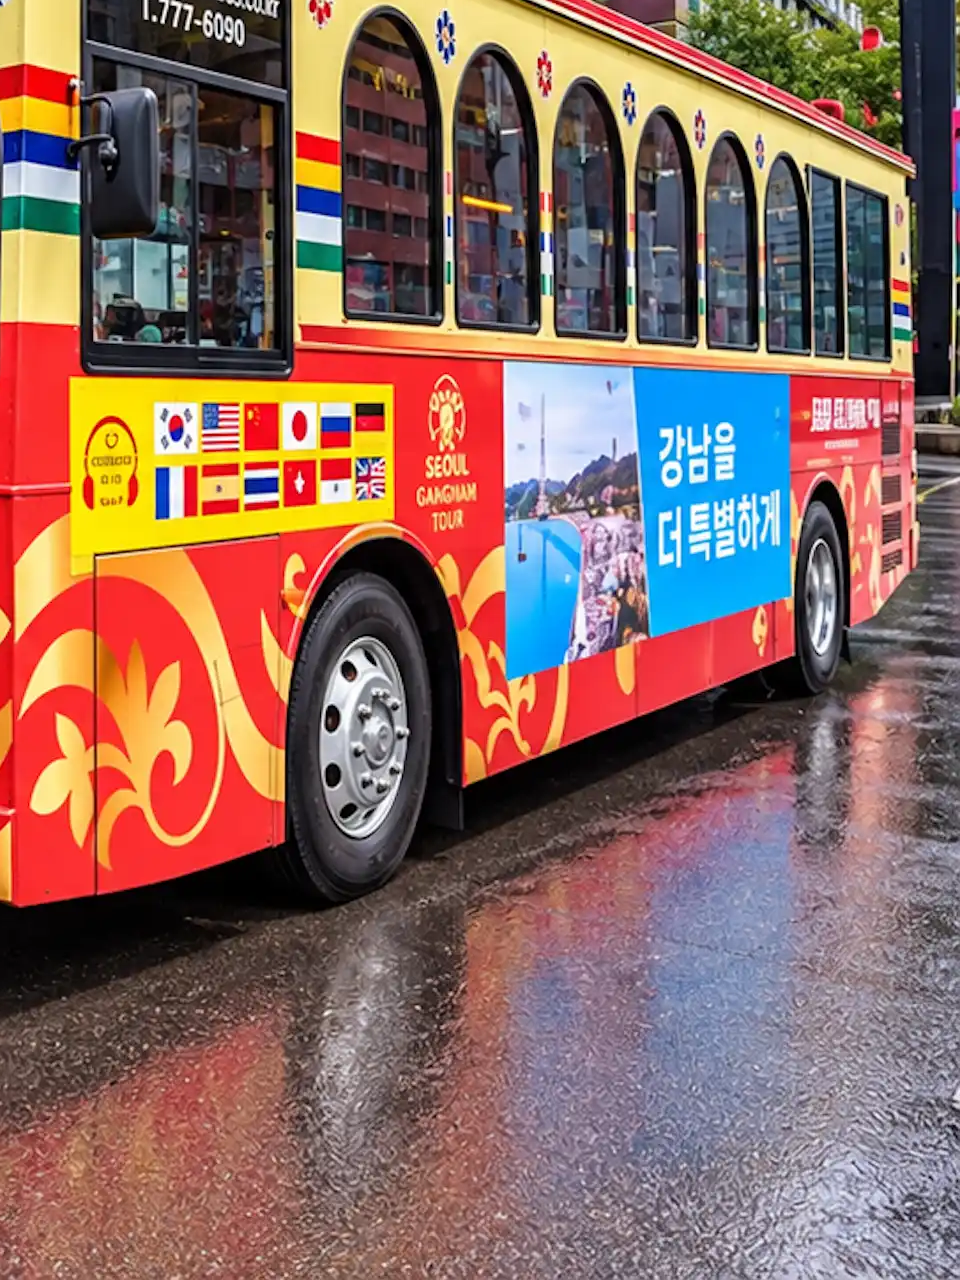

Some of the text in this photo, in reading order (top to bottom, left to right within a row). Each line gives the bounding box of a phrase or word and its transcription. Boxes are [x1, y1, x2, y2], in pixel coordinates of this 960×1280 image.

[425, 453, 470, 479] SEOUL
[658, 421, 737, 488] 강남을
[431, 509, 464, 532] TOUR
[658, 489, 780, 568] 더 특별하게
